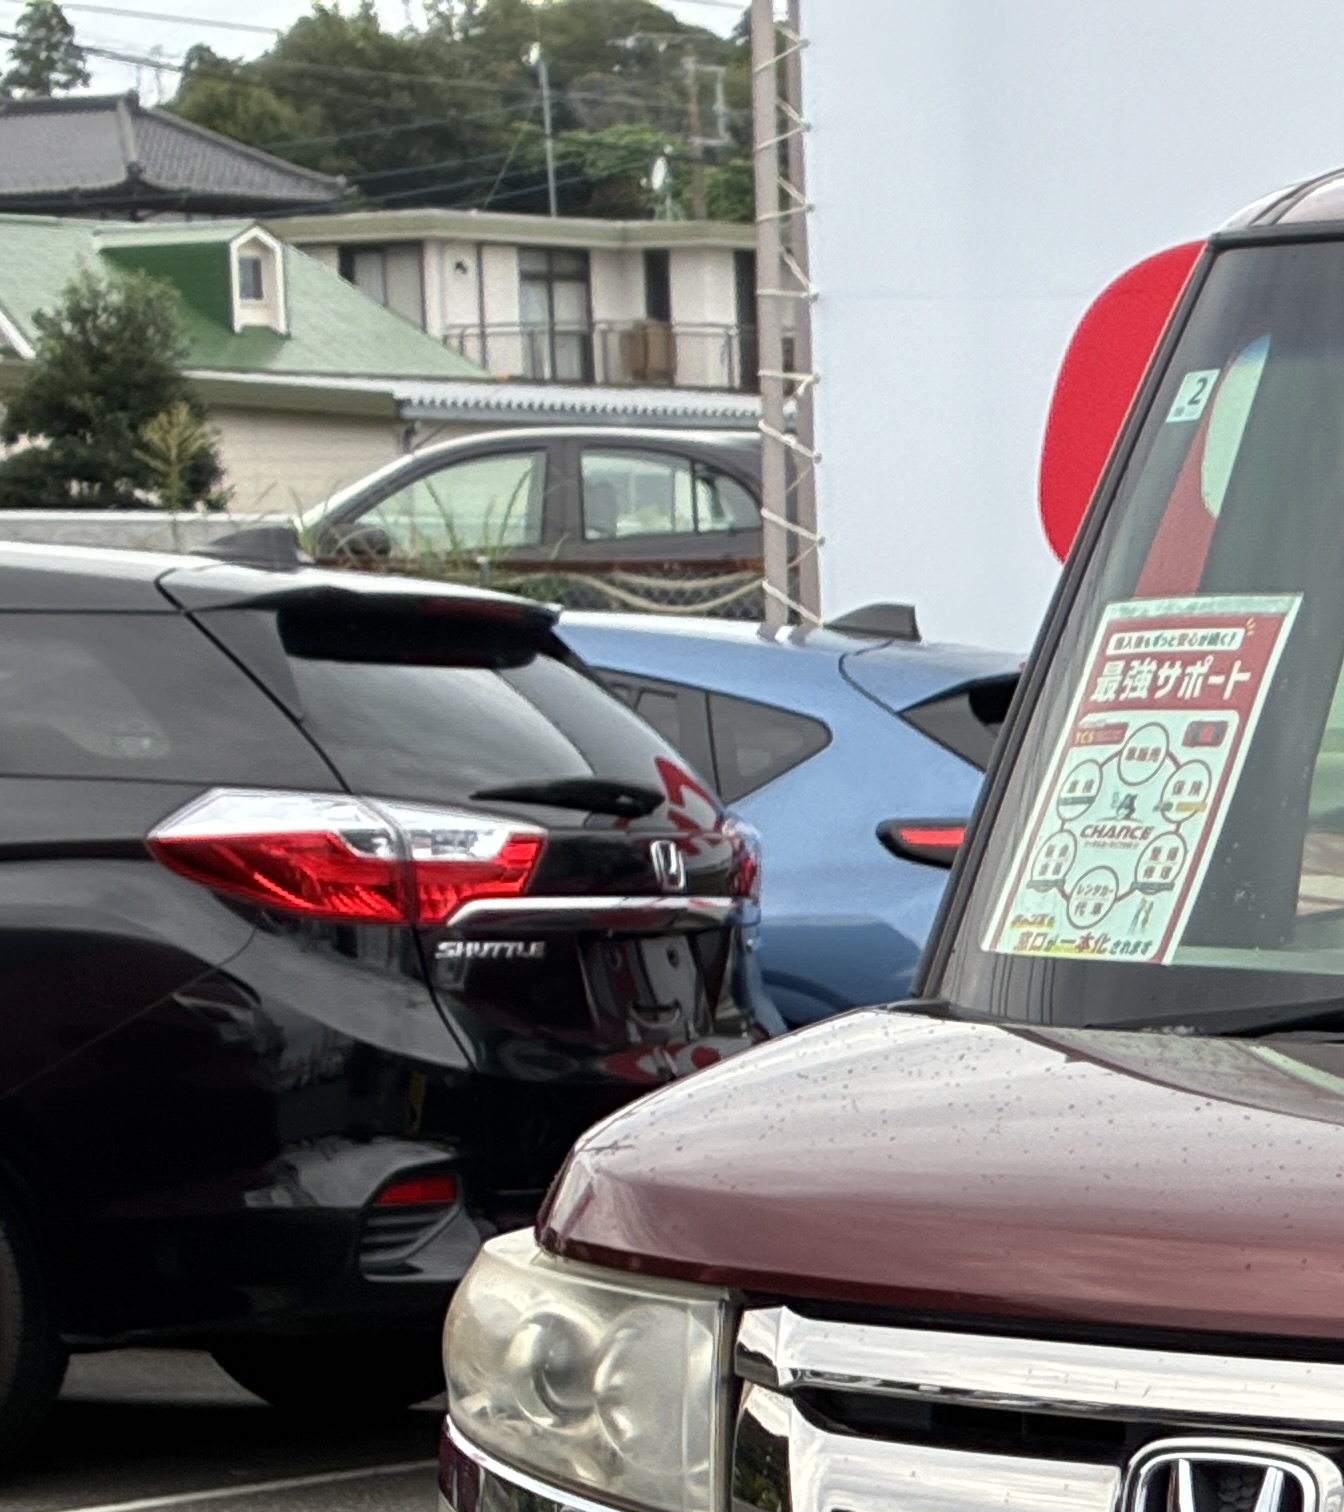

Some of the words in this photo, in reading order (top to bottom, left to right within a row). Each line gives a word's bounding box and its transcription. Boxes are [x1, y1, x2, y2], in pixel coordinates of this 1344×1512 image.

[1187, 377, 1208, 405] 2
[1090, 655, 1253, 703] 最強サポート
[1080, 824, 1155, 841] CHANCE
[435, 941, 545, 959] SHUTTLE
